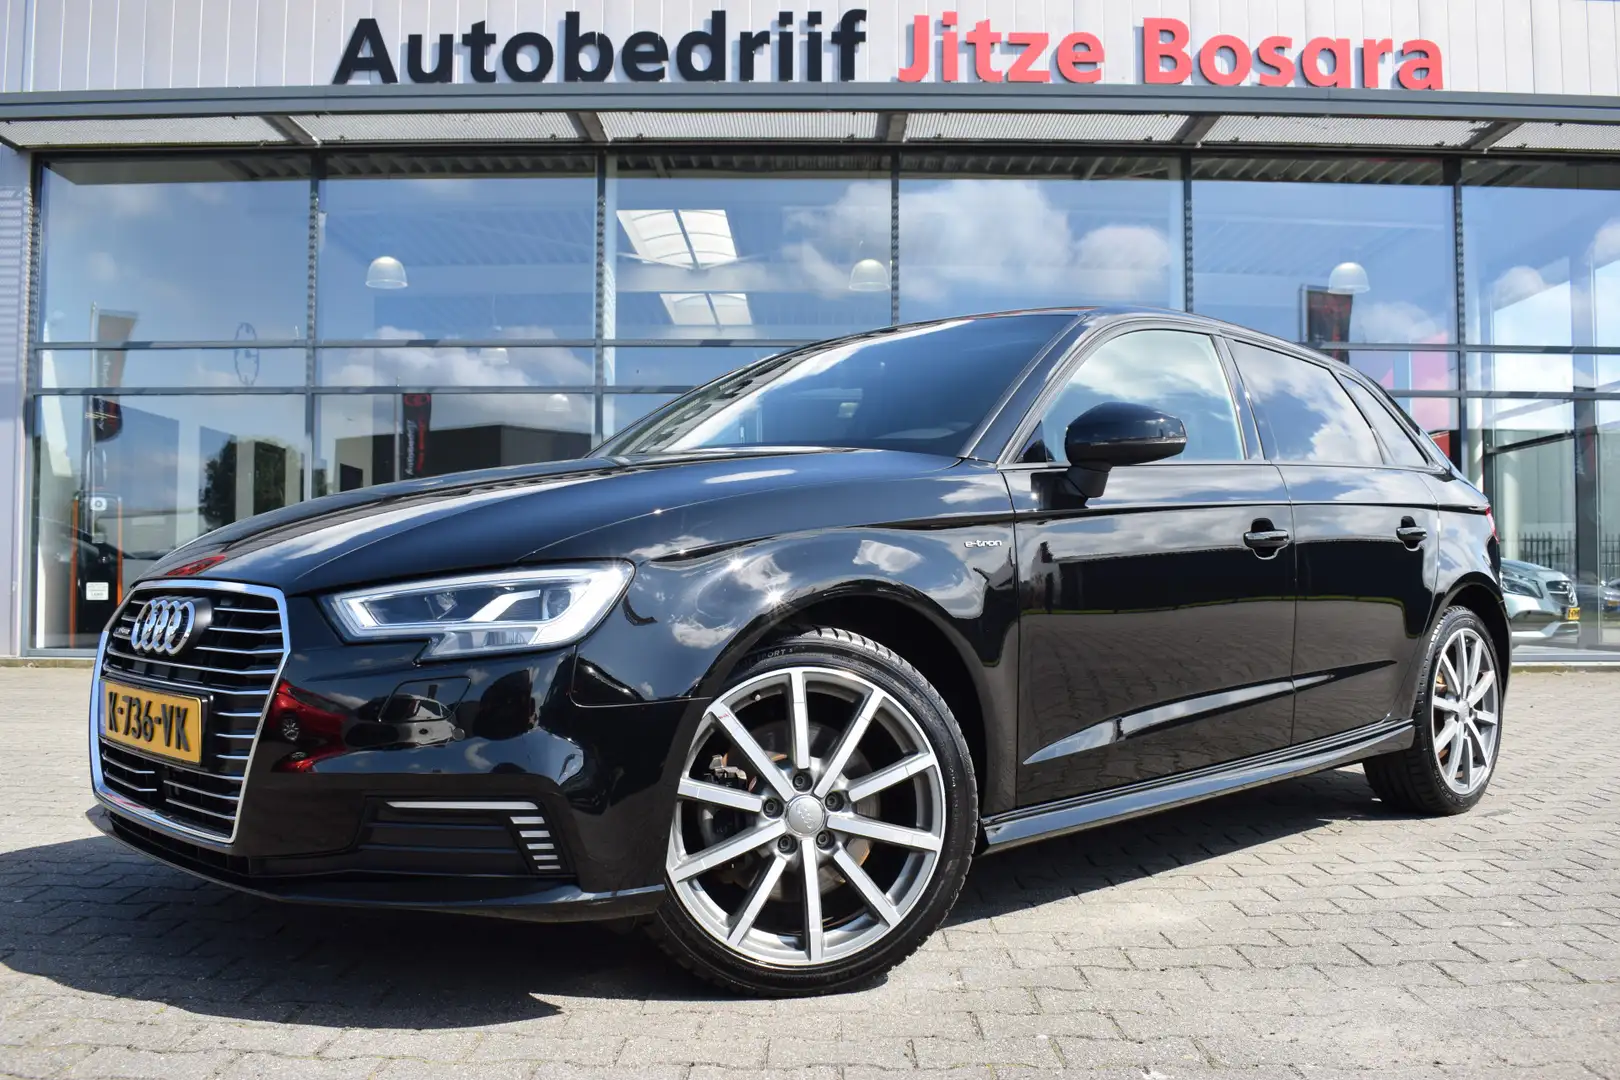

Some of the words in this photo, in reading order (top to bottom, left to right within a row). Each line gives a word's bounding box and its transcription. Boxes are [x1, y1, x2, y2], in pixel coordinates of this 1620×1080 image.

[898, 11, 1104, 84] Jitze
[964, 539, 1003, 548] e-tron
[108, 691, 190, 752] K-736-VK
